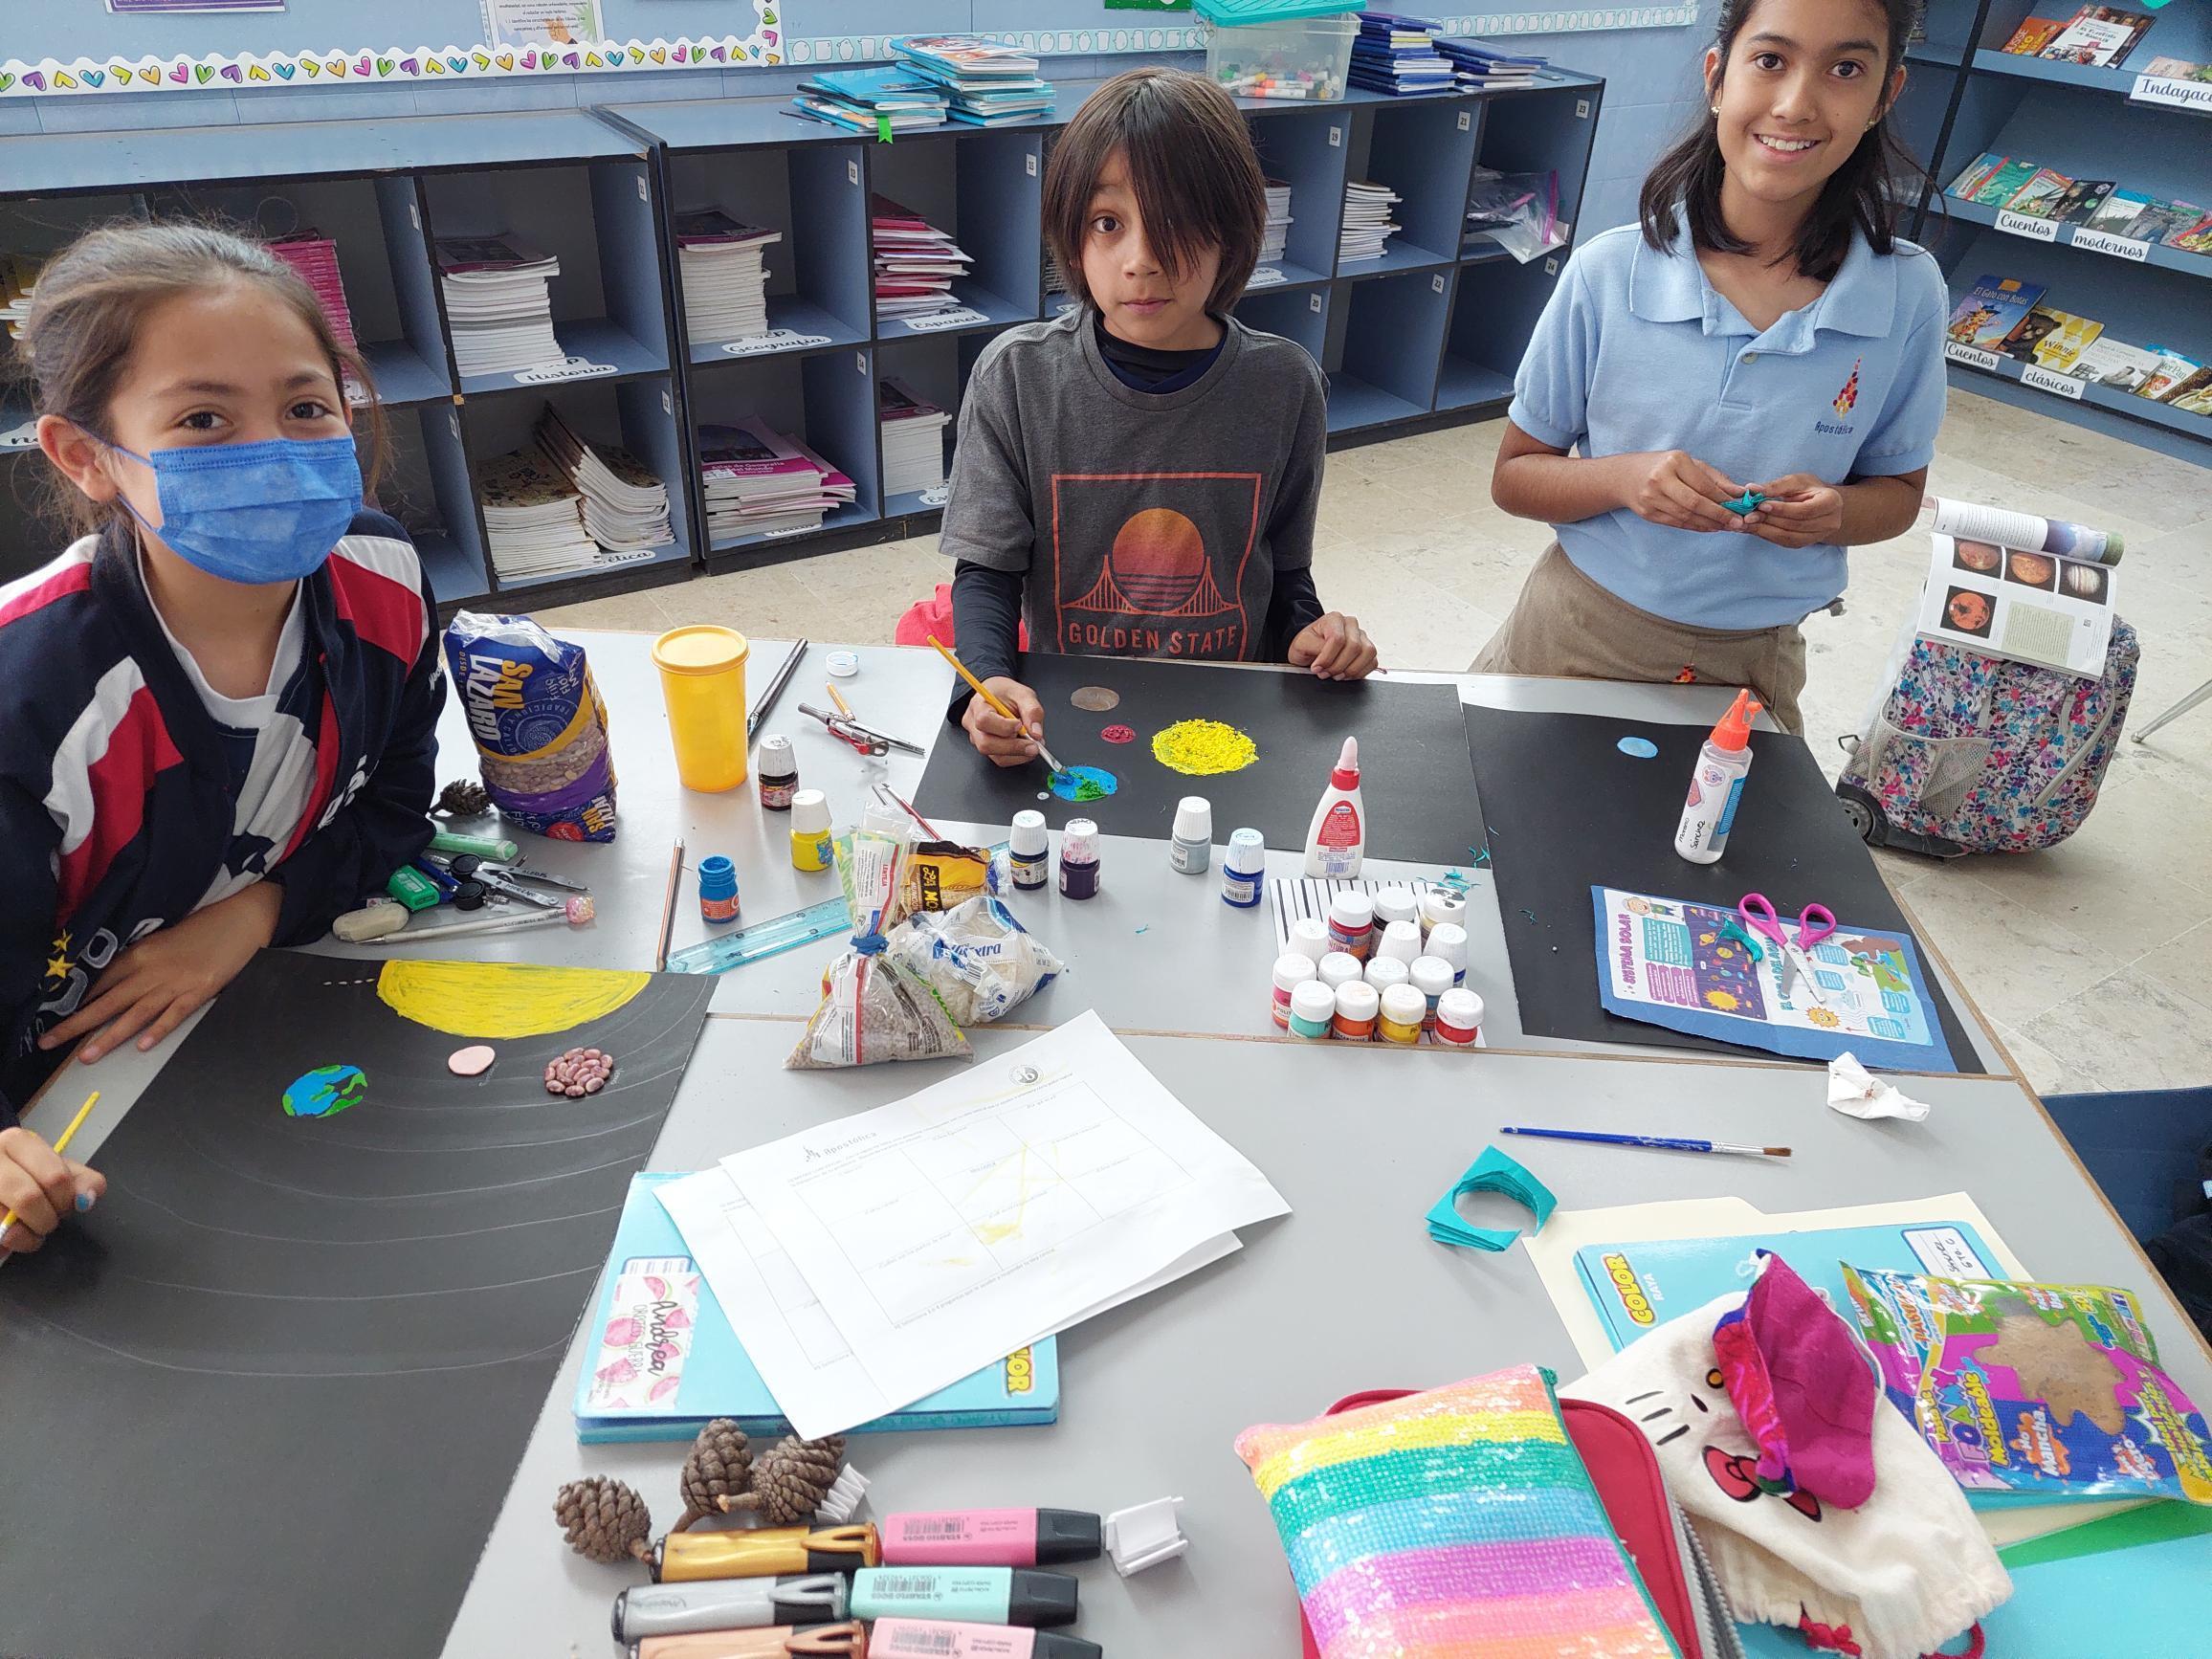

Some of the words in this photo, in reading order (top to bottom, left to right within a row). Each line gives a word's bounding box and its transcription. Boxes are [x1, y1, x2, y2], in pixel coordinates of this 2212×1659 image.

[1028, 161, 1034, 170] 15
[2000, 213, 2053, 237] Cuentos
[2074, 233, 2145, 259] modernos
[1974, 286, 1981, 296] El
[1981, 288, 1996, 299] Gato
[1996, 293, 2008, 301] con
[2009, 294, 2029, 305] Botas
[914, 316, 982, 329] Español
[1947, 343, 1996, 367] Cuentos
[2025, 371, 2077, 395] clásicos
[2043, 340, 2076, 358] Winnie
[526, 365, 612, 382] Historia
[1069, 622, 1160, 651] GOLDEN
[1169, 625, 1237, 654] STATE
[466, 653, 502, 741] LAZARO
[493, 660, 534, 709] SAN
[880, 864, 889, 887] LENTEJA
[1604, 1251, 1660, 1328] COLOR
[1640, 1272, 1664, 1302] RAYA
[644, 1300, 679, 1377] Andrea
[1929, 1368, 1988, 1461] FOAMY
[1963, 1372, 2011, 1468] Moldeable
[2032, 1409, 2060, 1476] Mancha
